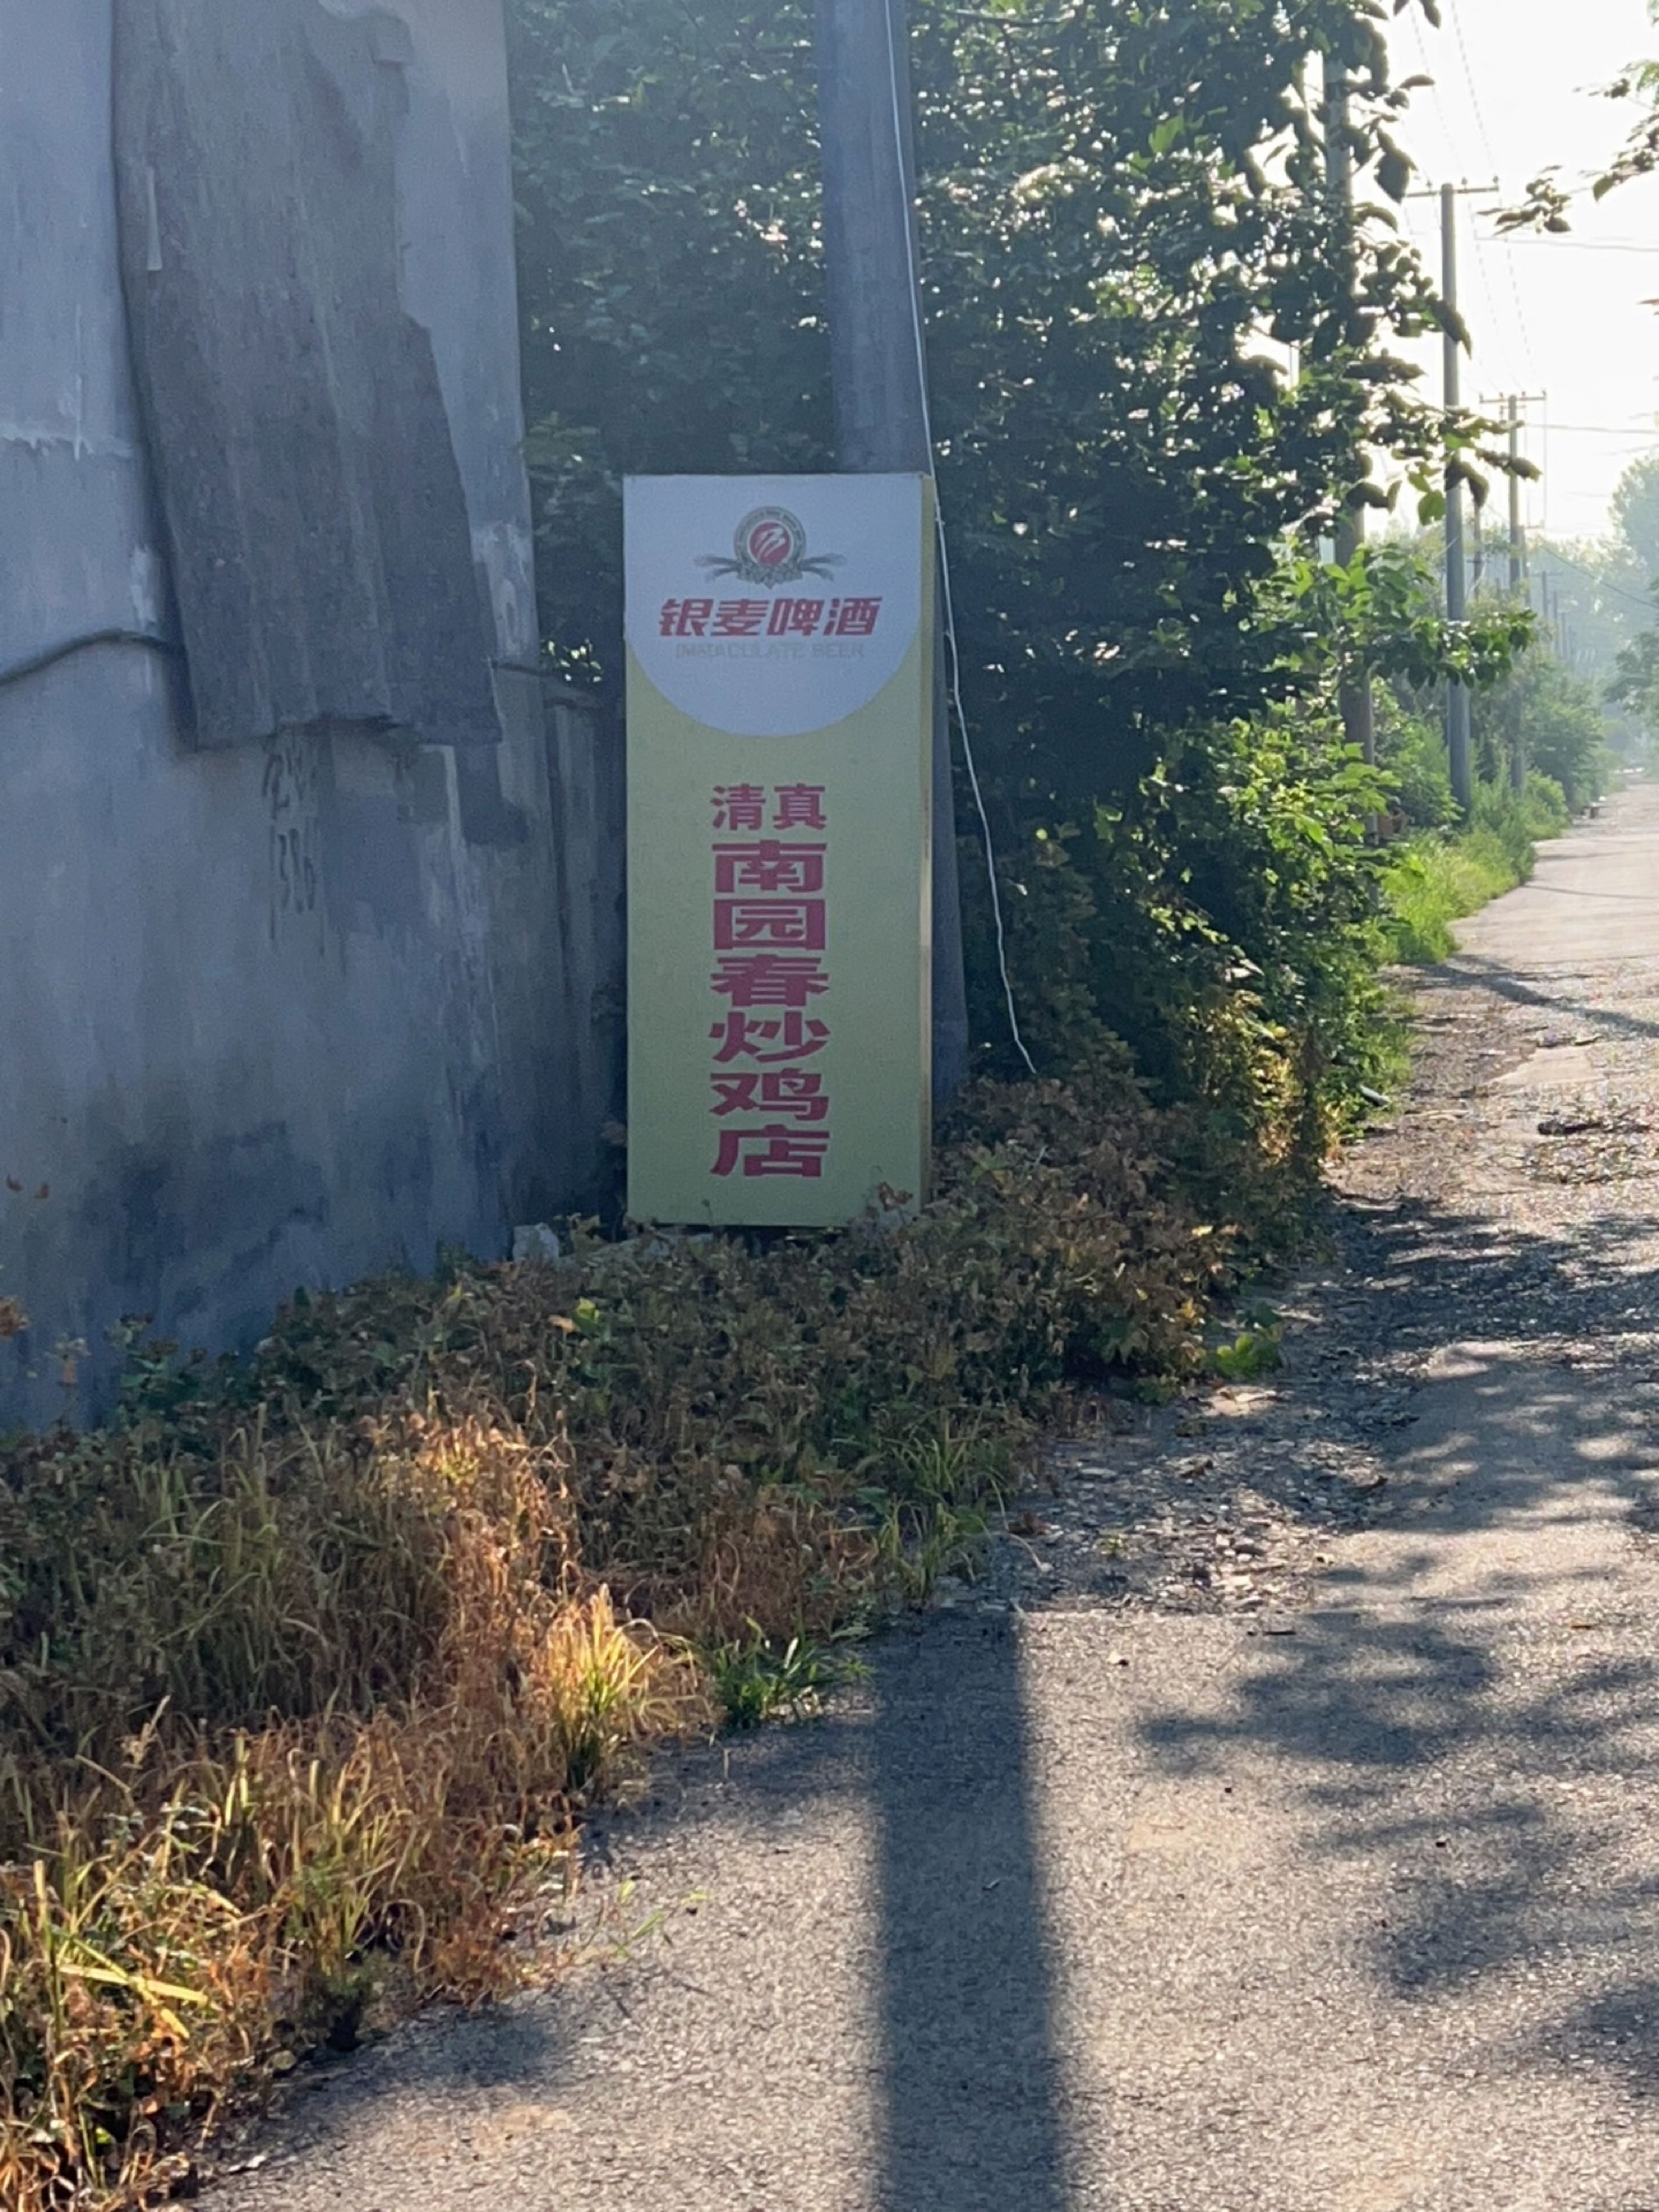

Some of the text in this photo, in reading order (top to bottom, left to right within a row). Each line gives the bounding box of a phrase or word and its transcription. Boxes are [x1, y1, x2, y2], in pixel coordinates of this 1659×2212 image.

[659, 597, 882, 636] 银麦啤酒
[812, 643, 864, 658] BEER
[709, 783, 826, 830] 清真
[709, 840, 830, 1176] 南园春炒鸡店
